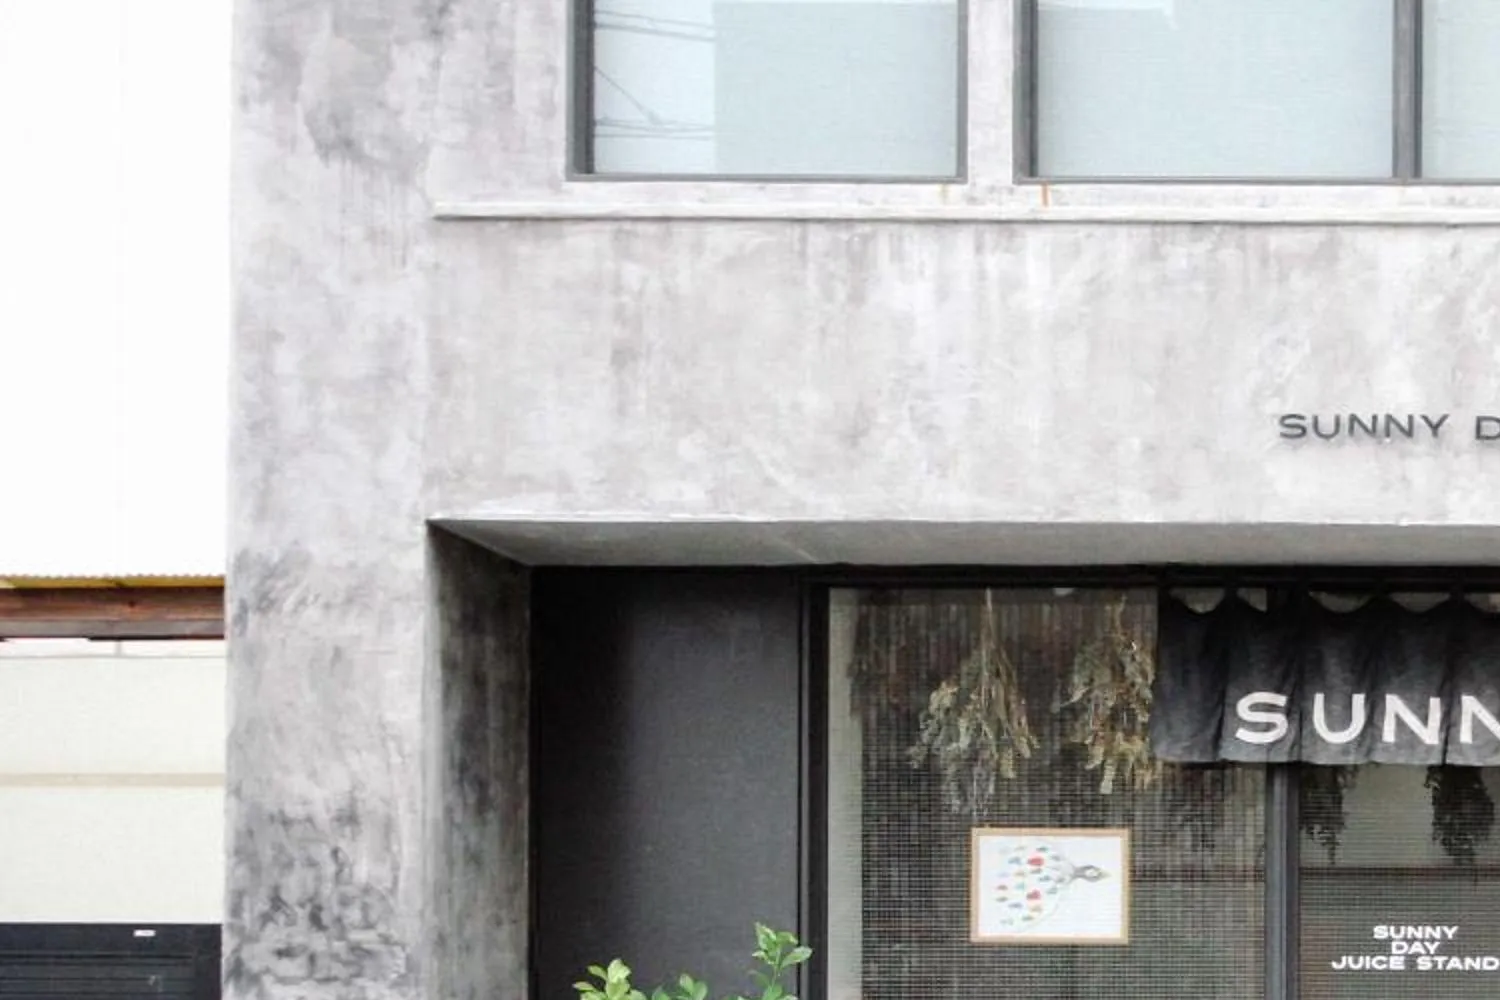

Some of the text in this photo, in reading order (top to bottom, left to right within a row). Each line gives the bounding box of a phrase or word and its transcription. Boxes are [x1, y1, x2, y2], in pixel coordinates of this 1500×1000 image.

[1278, 412, 1451, 440] SUNNY
[1373, 924, 1459, 940] SUNNY
[1391, 941, 1440, 955] DAY
[1331, 955, 1500, 971] JUICE STAND
